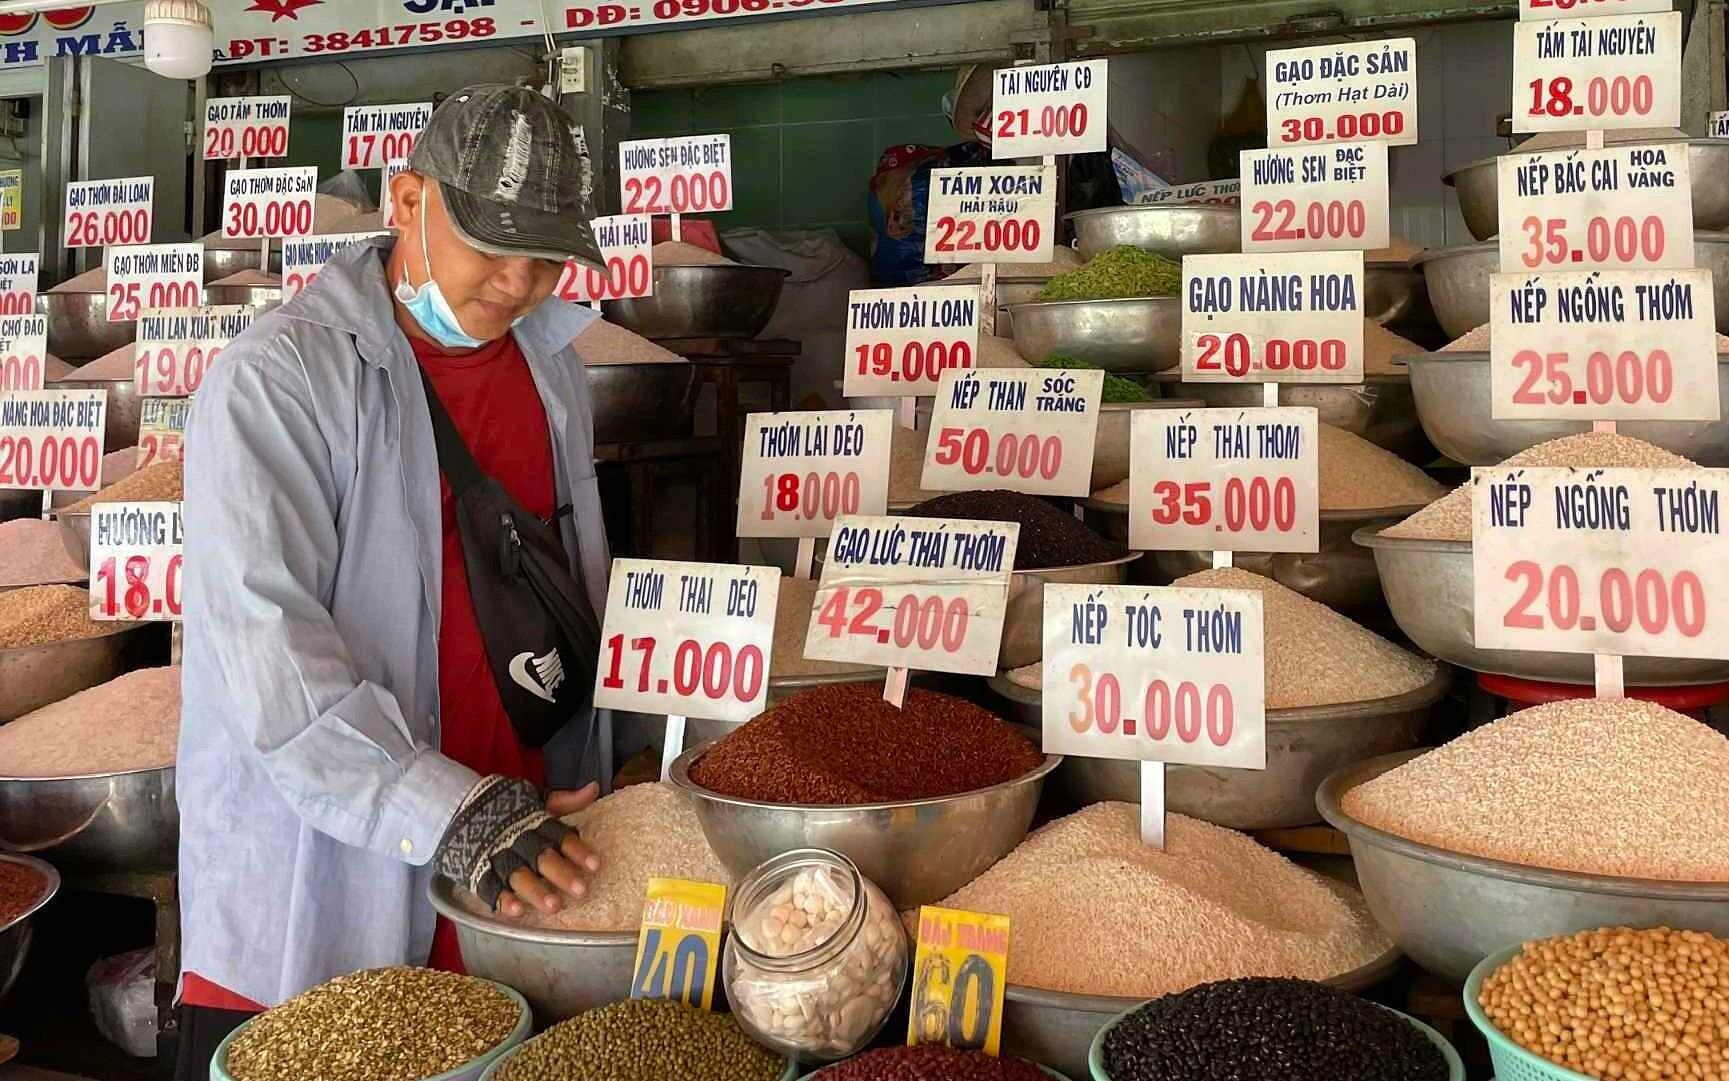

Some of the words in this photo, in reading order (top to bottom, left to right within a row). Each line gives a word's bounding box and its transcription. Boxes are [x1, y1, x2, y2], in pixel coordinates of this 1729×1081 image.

[0, 40, 39, 63] H
[56, 21, 144, 58] MẪ
[228, 37, 289, 59] ĐT:
[302, 17, 496, 53] 38417598
[566, 4, 641, 28] DĐ:
[1536, 21, 1565, 58] TẤM
[1571, 22, 1592, 57] TÀI
[1599, 20, 1656, 56] NGUYÊN
[1025, 65, 1068, 93] NGUYÊN
[1075, 66, 1092, 89] CĐ
[1275, 58, 1313, 86] GẠO
[1320, 52, 1359, 82] ĐẶC
[1367, 45, 1408, 74] SẢN
[208, 103, 228, 122] GẠO
[1275, 91, 1331, 110] (Thơm
[1338, 86, 1369, 104] Hạt
[1374, 82, 1409, 101] Dài)
[1528, 75, 1654, 117] 18.000
[206, 126, 287, 157] 20.000
[1281, 111, 1404, 143] 30.000
[1710, 113, 1729, 136] TẤ
[659, 146, 677, 167] SEN
[703, 138, 725, 167] BIỆT
[1254, 154, 1294, 185] HƯƠNG
[1302, 155, 1326, 183] SEN
[1631, 150, 1666, 166] HOA
[230, 179, 247, 198] GẠO
[625, 171, 728, 213] 22.000
[940, 171, 982, 195] TÁM
[989, 175, 1042, 195] XOAN
[1213, 182, 1240, 195] THƠ
[1517, 156, 1549, 197] NẾP
[1555, 151, 1586, 194] BẮC
[1591, 159, 1618, 191] CAI
[1627, 167, 1674, 188] VÀNG
[70, 187, 86, 210] GẠO
[129, 183, 150, 203] LOAN
[67, 209, 148, 246] 26.000
[226, 200, 312, 237] 30.000
[600, 217, 619, 248] HẢI
[623, 217, 648, 249] HẬU
[935, 216, 1040, 252] 22.000
[1251, 199, 1366, 241] 22.000
[1521, 215, 1665, 268] 35.000
[21, 260, 35, 275] LA
[114, 255, 130, 278] GẠO
[186, 253, 200, 273] ĐB
[851, 298, 894, 329] THƠM
[899, 294, 926, 328] ĐÀI
[931, 300, 974, 328] LOAN
[1189, 277, 1232, 320] GẠO
[1240, 268, 1302, 312] NÀNG
[1310, 274, 1356, 311] HOA
[1511, 277, 1547, 323] NẾP
[1558, 272, 1625, 323] NGỖNG
[1635, 279, 1693, 321] THƠM
[168, 317, 187, 339] LAN
[855, 340, 971, 382] 19.000
[1196, 333, 1346, 377] 20.000
[951, 371, 981, 410] NẾP
[988, 381, 1027, 411] THAN
[1042, 372, 1076, 394] SÓC
[1511, 350, 1673, 405] 25.000
[30, 400, 49, 427] HOA
[760, 421, 800, 457] THƠM
[804, 416, 828, 456] LÀI
[833, 412, 864, 456] DẺO
[935, 427, 1062, 480] 50.000
[1213, 411, 1250, 459] THÁI
[0, 435, 100, 488] 20.000
[761, 471, 860, 520] 18.000
[1152, 477, 1295, 532] 35.000
[1490, 470, 1531, 528] NẾP
[1653, 480, 1720, 534] THƠM
[98, 507, 166, 545] HƯƠNG
[172, 512, 184, 545] L
[834, 527, 869, 568] GẠO
[908, 524, 950, 568] THÁI
[952, 529, 1005, 572] THƠM
[625, 567, 664, 610] THƠM
[1503, 560, 1706, 638] 20.000
[818, 587, 969, 653] 42.000
[1072, 590, 1108, 644] NẾP
[1125, 593, 1162, 649] TÓC
[1184, 603, 1242, 654] THƠM
[603, 634, 763, 703] 17.000
[1068, 663, 1234, 747] 30.000
[631, 928, 709, 1008] 40
